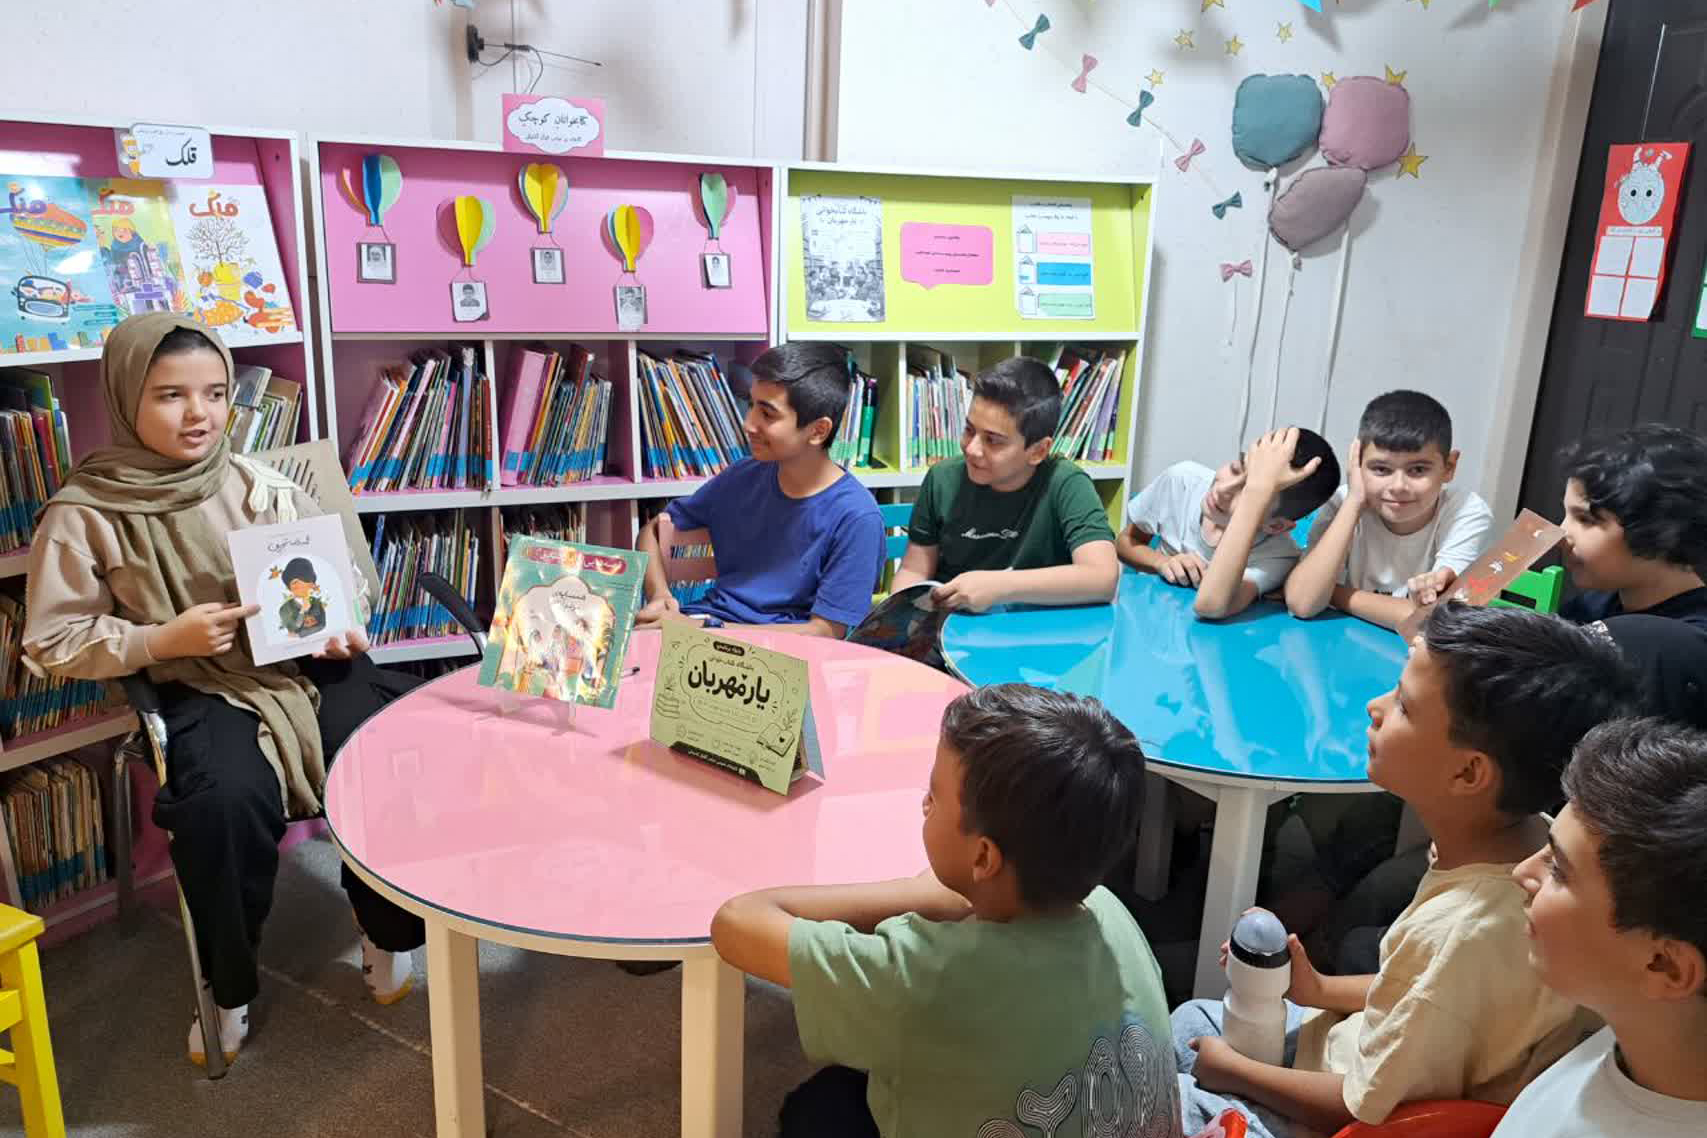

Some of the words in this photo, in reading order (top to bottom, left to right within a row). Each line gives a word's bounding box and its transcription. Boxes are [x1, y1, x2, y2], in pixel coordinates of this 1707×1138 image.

[165, 138, 197, 167] قلک
[688, 660, 746, 699] مهربان
[743, 676, 770, 710] یار
